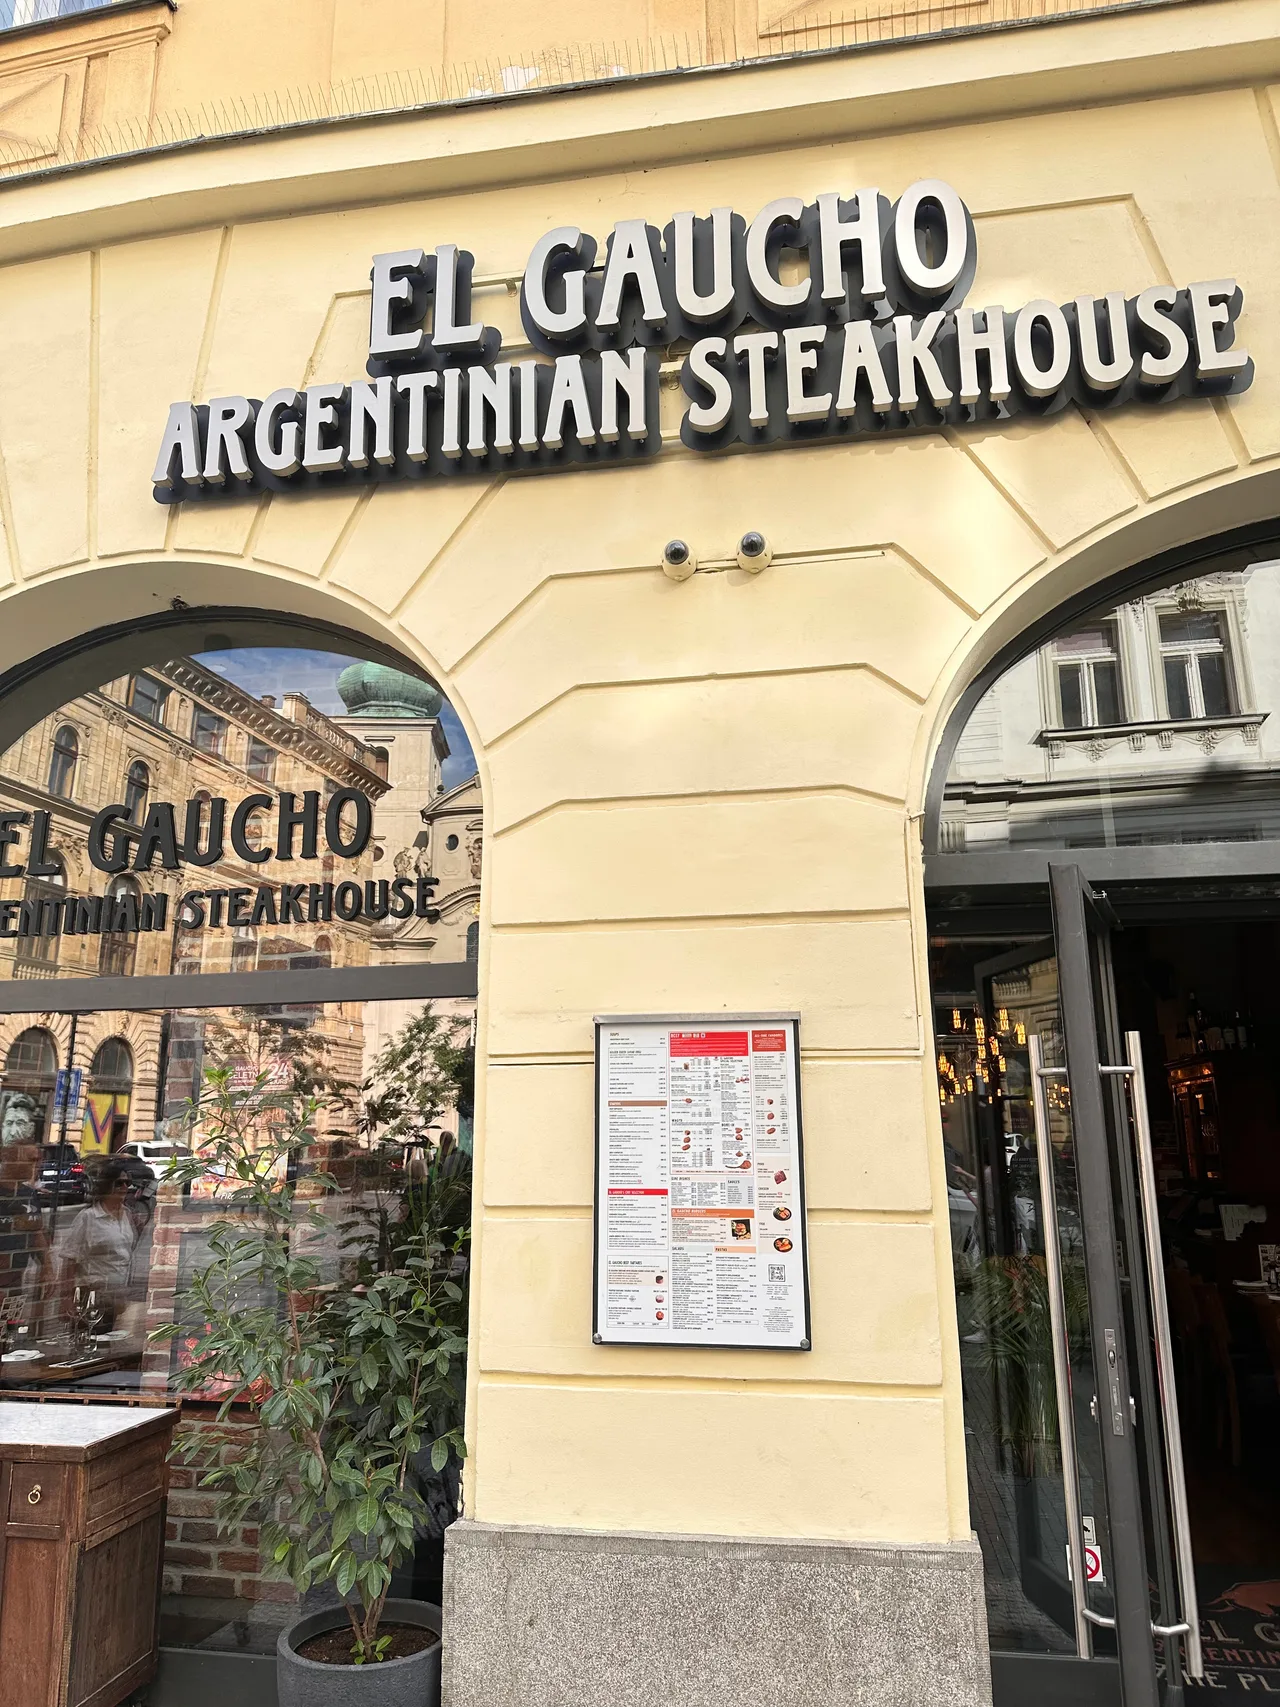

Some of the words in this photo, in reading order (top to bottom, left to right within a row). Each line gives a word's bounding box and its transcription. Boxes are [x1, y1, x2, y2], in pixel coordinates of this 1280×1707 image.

[369, 244, 487, 362] EL
[525, 178, 968, 339] GAUCHO
[152, 347, 648, 488] ARGENTINIAN
[688, 278, 1249, 433] STEAKHOUSE
[87, 787, 373, 874] GAUCHO
[181, 877, 440, 929] STEAKHOUSE
[268, 1063, 288, 1079] 24
